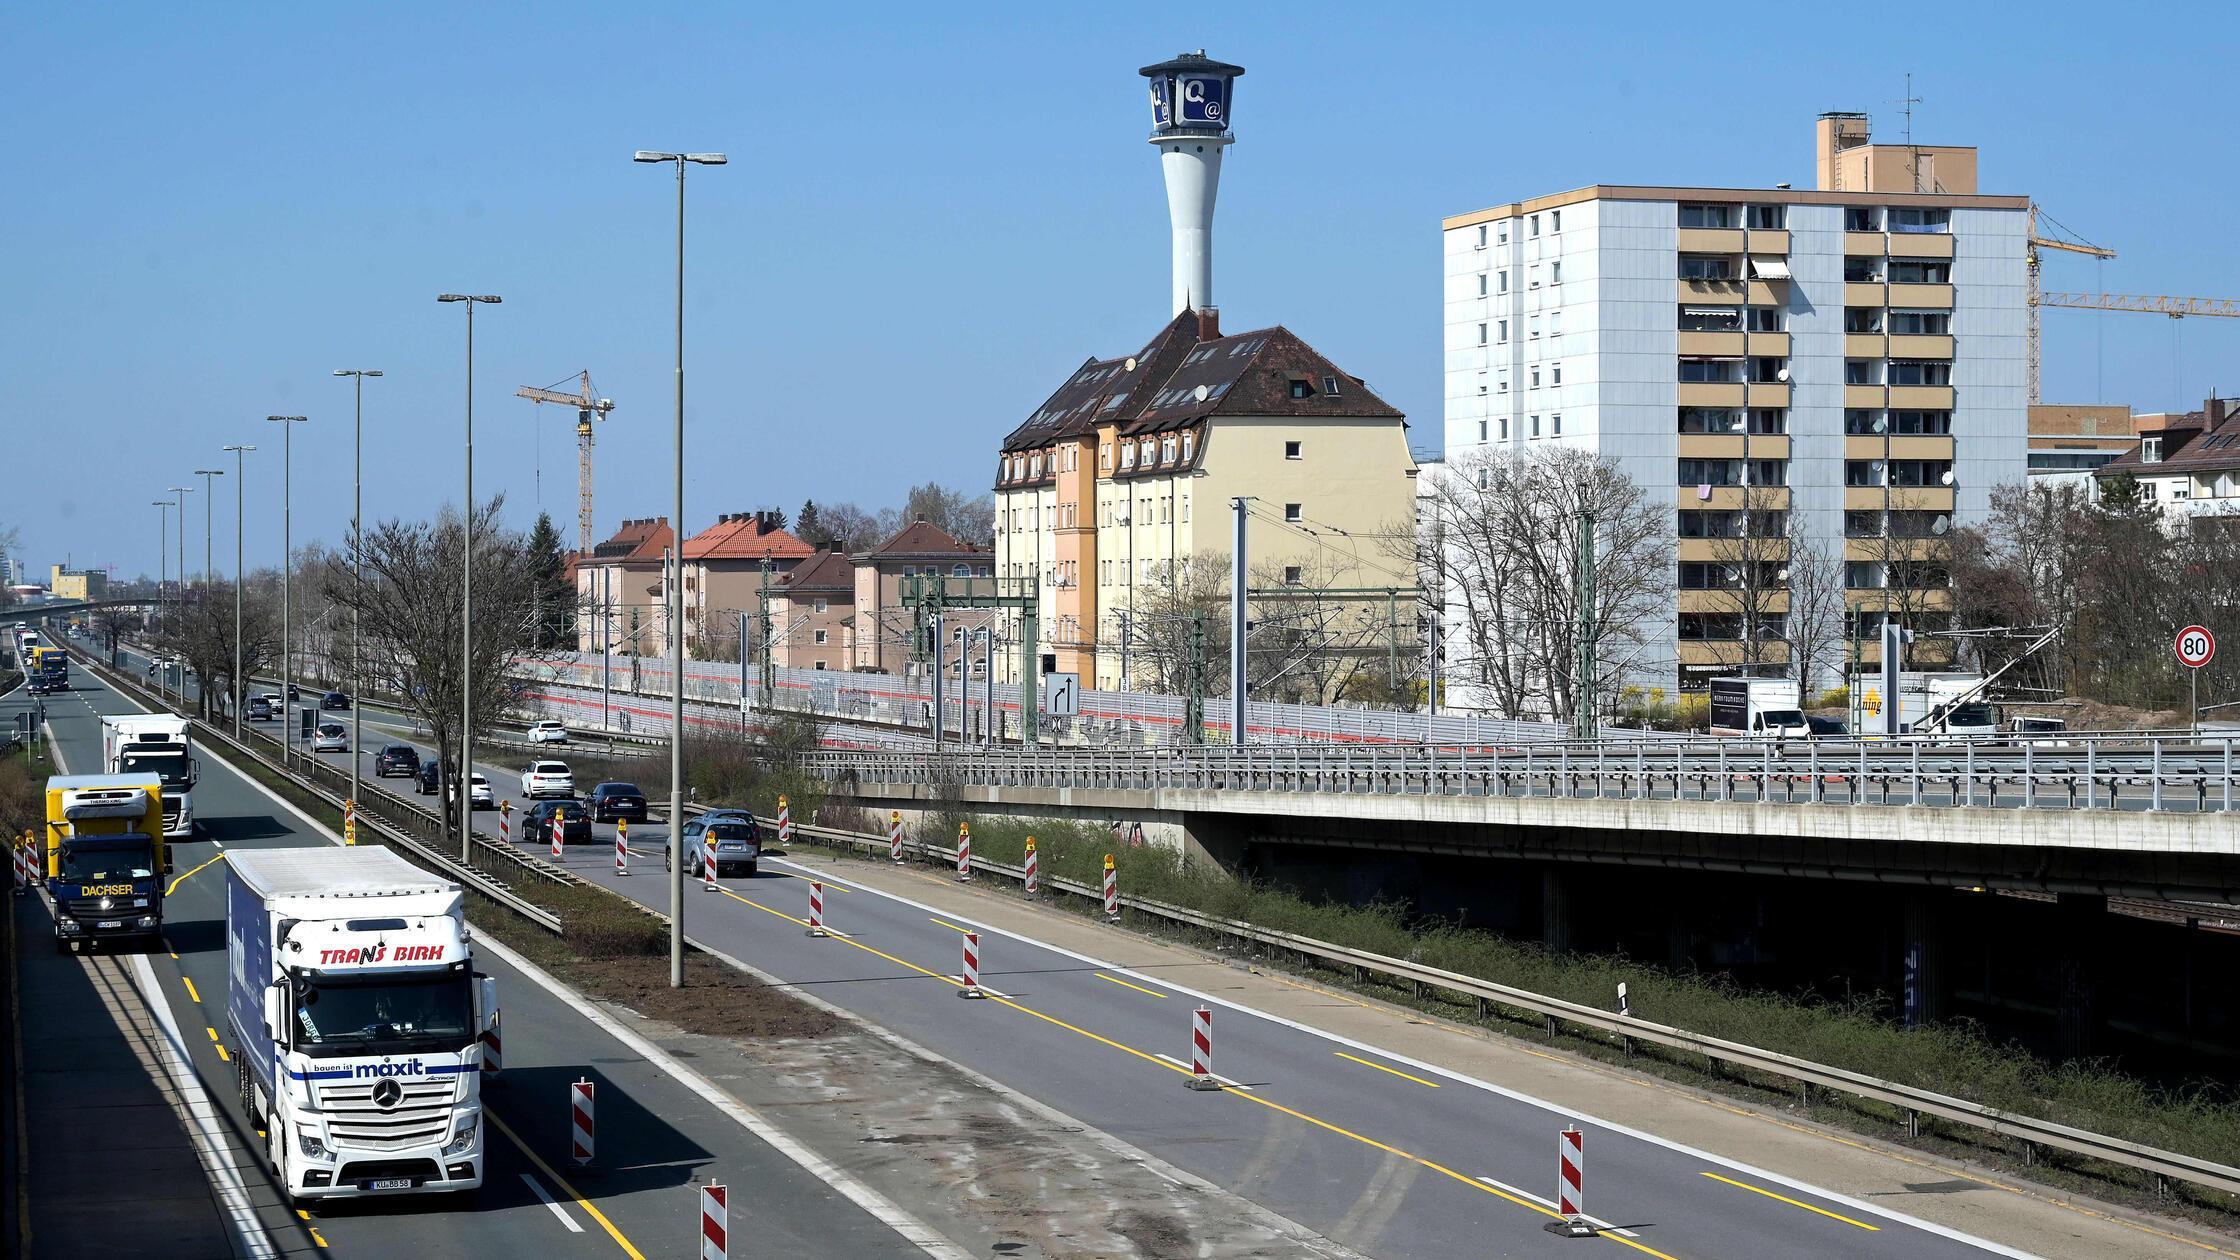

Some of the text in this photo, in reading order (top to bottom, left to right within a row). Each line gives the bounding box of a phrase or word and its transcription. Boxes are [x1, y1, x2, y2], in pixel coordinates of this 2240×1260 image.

[1153, 84, 1162, 106] Q
[1185, 80, 1205, 103] Q
[1204, 101, 1221, 119] @
[2184, 638, 2205, 655] 80
[81, 884, 133, 897] DACHSER
[320, 945, 445, 965] TRANS BIRK
[314, 1064, 341, 1072] bauen
[356, 1058, 423, 1078] maxit
